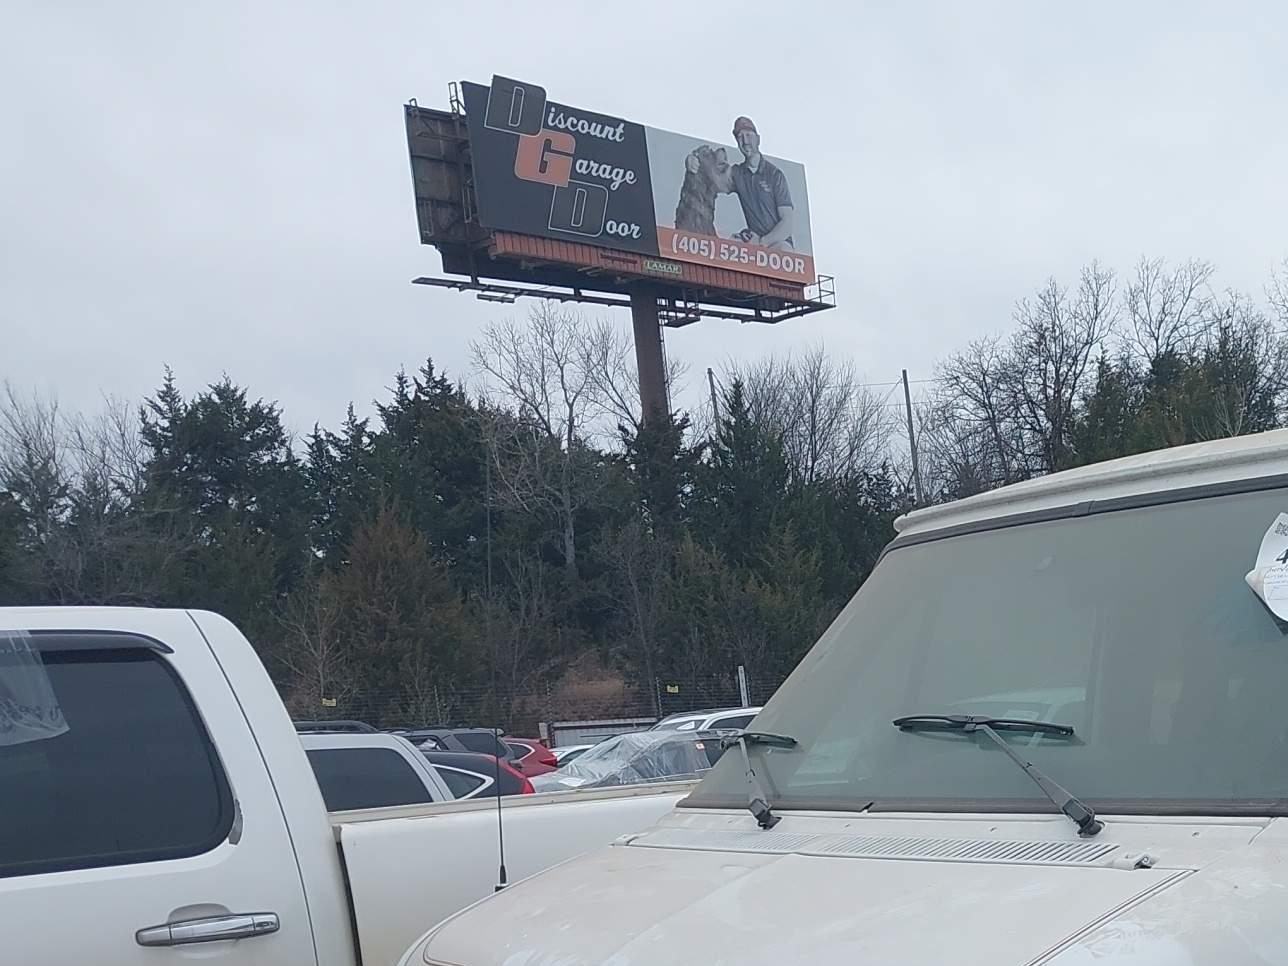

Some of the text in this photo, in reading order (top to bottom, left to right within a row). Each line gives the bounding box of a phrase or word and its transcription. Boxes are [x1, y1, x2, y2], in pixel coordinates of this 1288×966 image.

[484, 74, 625, 142] Discount
[514, 127, 637, 191] Garage
[548, 179, 641, 238] Door
[646, 259, 681, 273] LAMAR
[671, 235, 806, 275] (405) 525-DOOR
